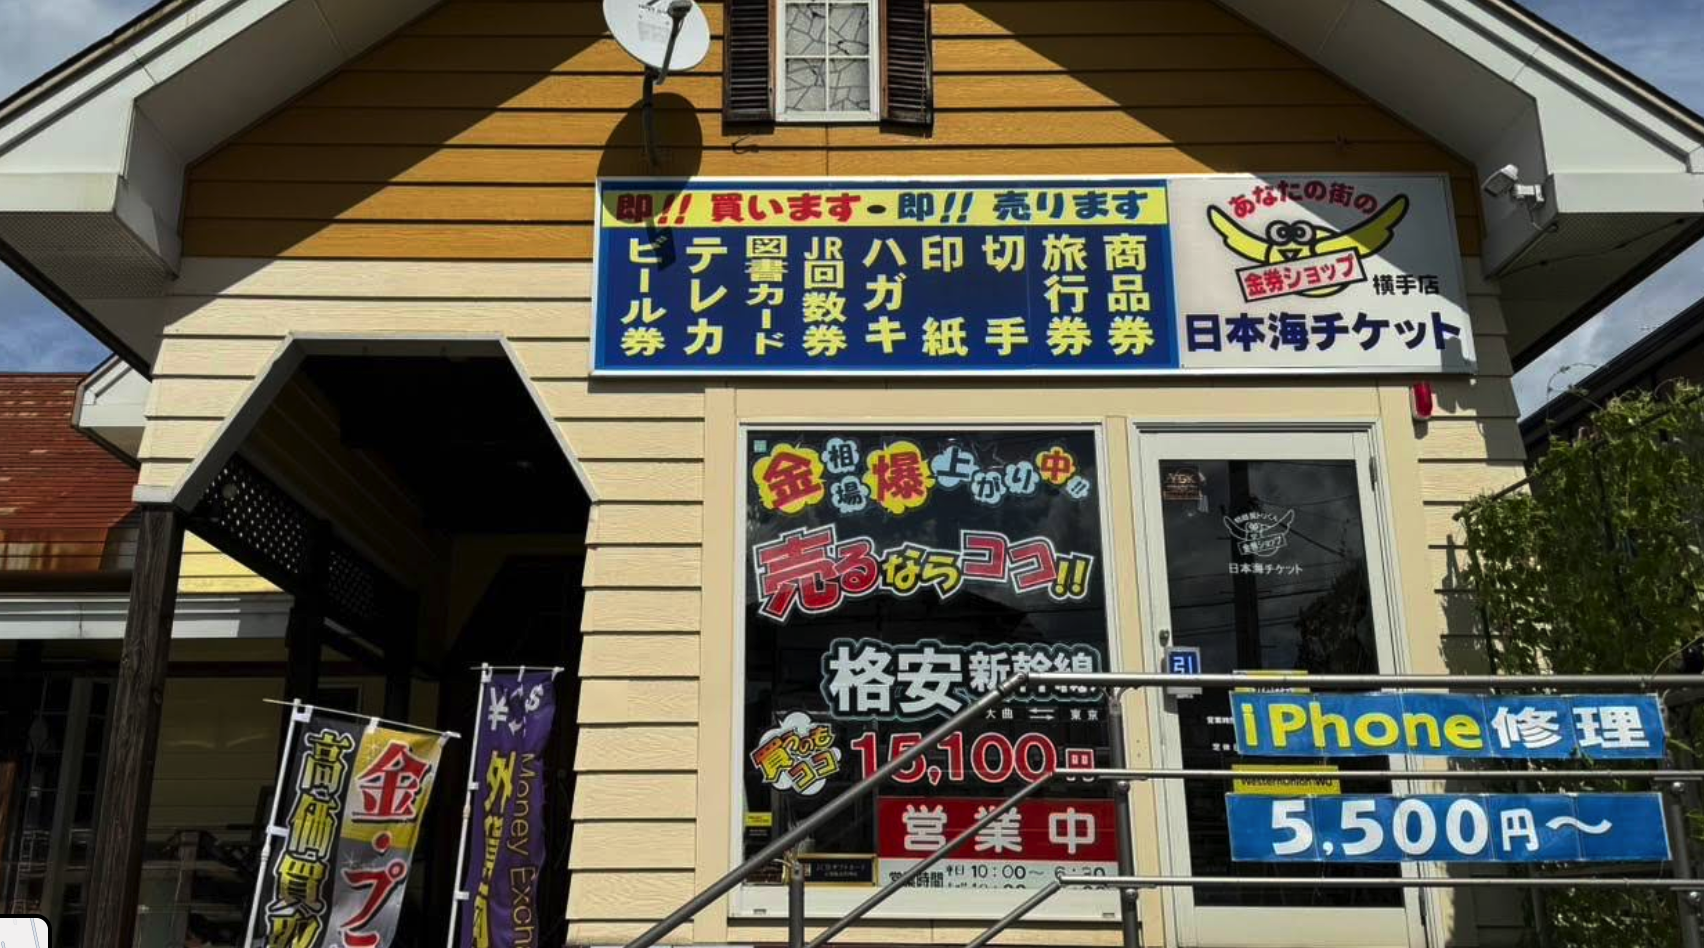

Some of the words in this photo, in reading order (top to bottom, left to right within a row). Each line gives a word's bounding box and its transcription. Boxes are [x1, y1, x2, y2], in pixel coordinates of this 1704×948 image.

[992, 192, 1148, 221] 売ります
[1228, 180, 1379, 218] あなたの街の
[620, 237, 667, 357] ビール券
[682, 236, 728, 356] テレカ
[745, 234, 789, 356] 図書カード
[802, 235, 849, 357] JR回数券
[861, 236, 907, 354] ハガキ
[1041, 233, 1093, 357] 旅行券
[1102, 233, 1156, 356] 商品券
[1243, 253, 1356, 297] 金券ショップ
[1372, 273, 1441, 296] 横手店
[1185, 311, 1461, 352] 日本海チケット
[1228, 562, 1304, 575] 日本海チケット
[1069, 708, 1099, 721] 東京
[339, 741, 432, 948] 金・プ
[507, 753, 536, 856] Money
[901, 804, 1097, 855] 営業中
[510, 866, 537, 948] Exch
